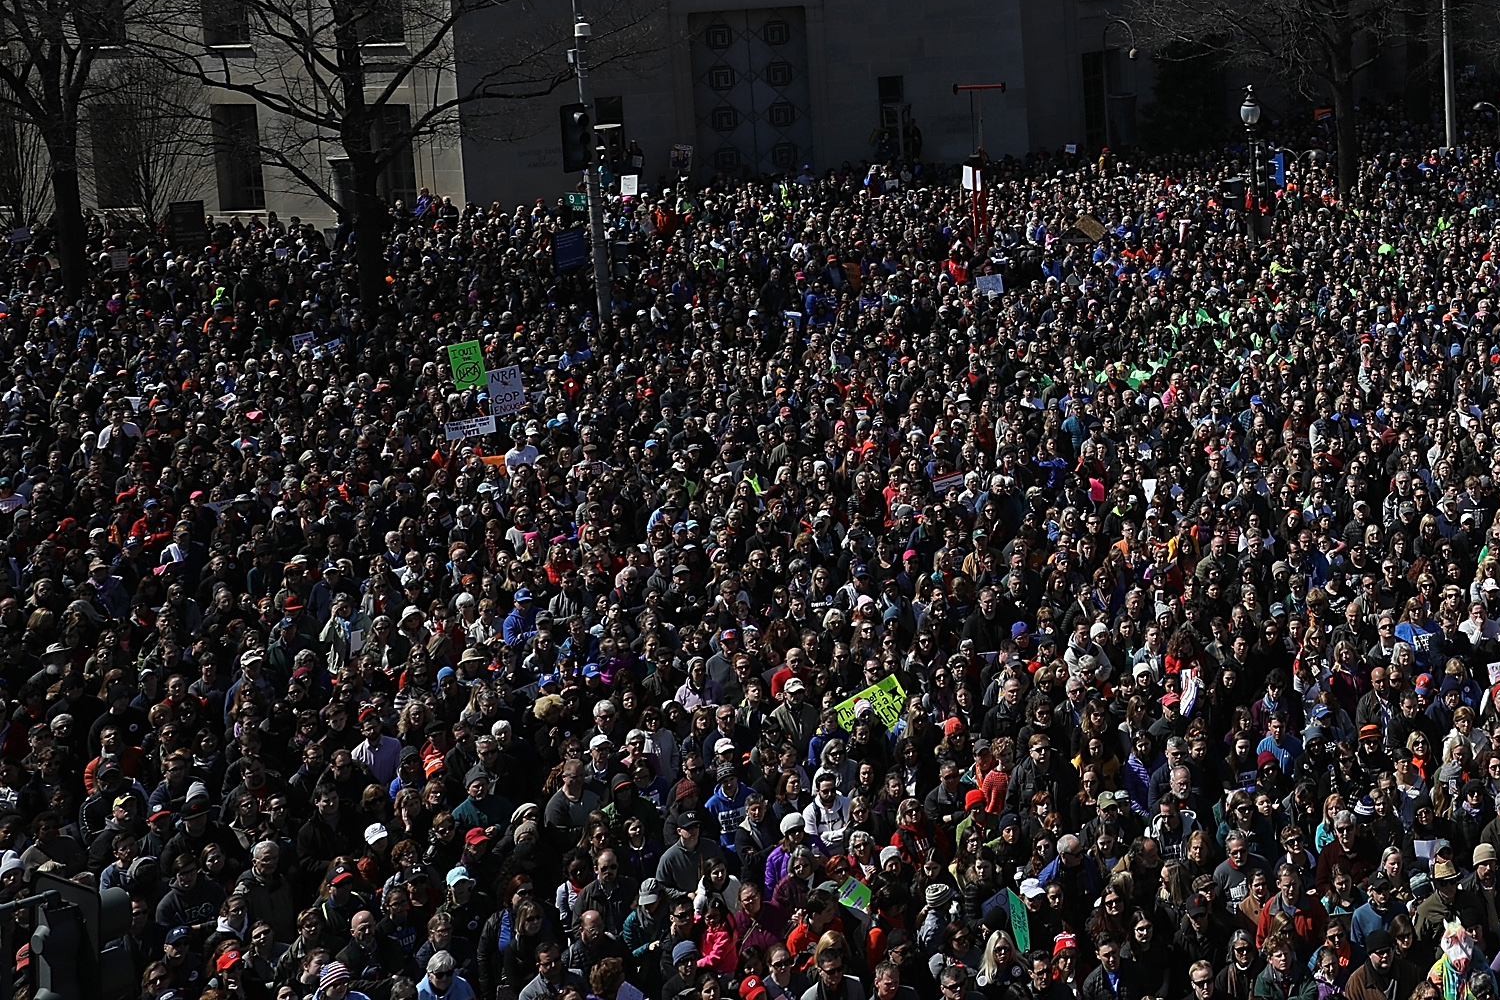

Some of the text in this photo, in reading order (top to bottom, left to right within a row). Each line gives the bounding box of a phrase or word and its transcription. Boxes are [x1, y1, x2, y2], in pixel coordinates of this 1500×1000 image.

[568, 194, 575, 204] 9
[458, 365, 478, 377] NRA
[491, 369, 516, 383] NRA
[495, 391, 519, 404] GOP
[462, 428, 480, 437] VOTE
[986, 893, 1008, 908] TO
